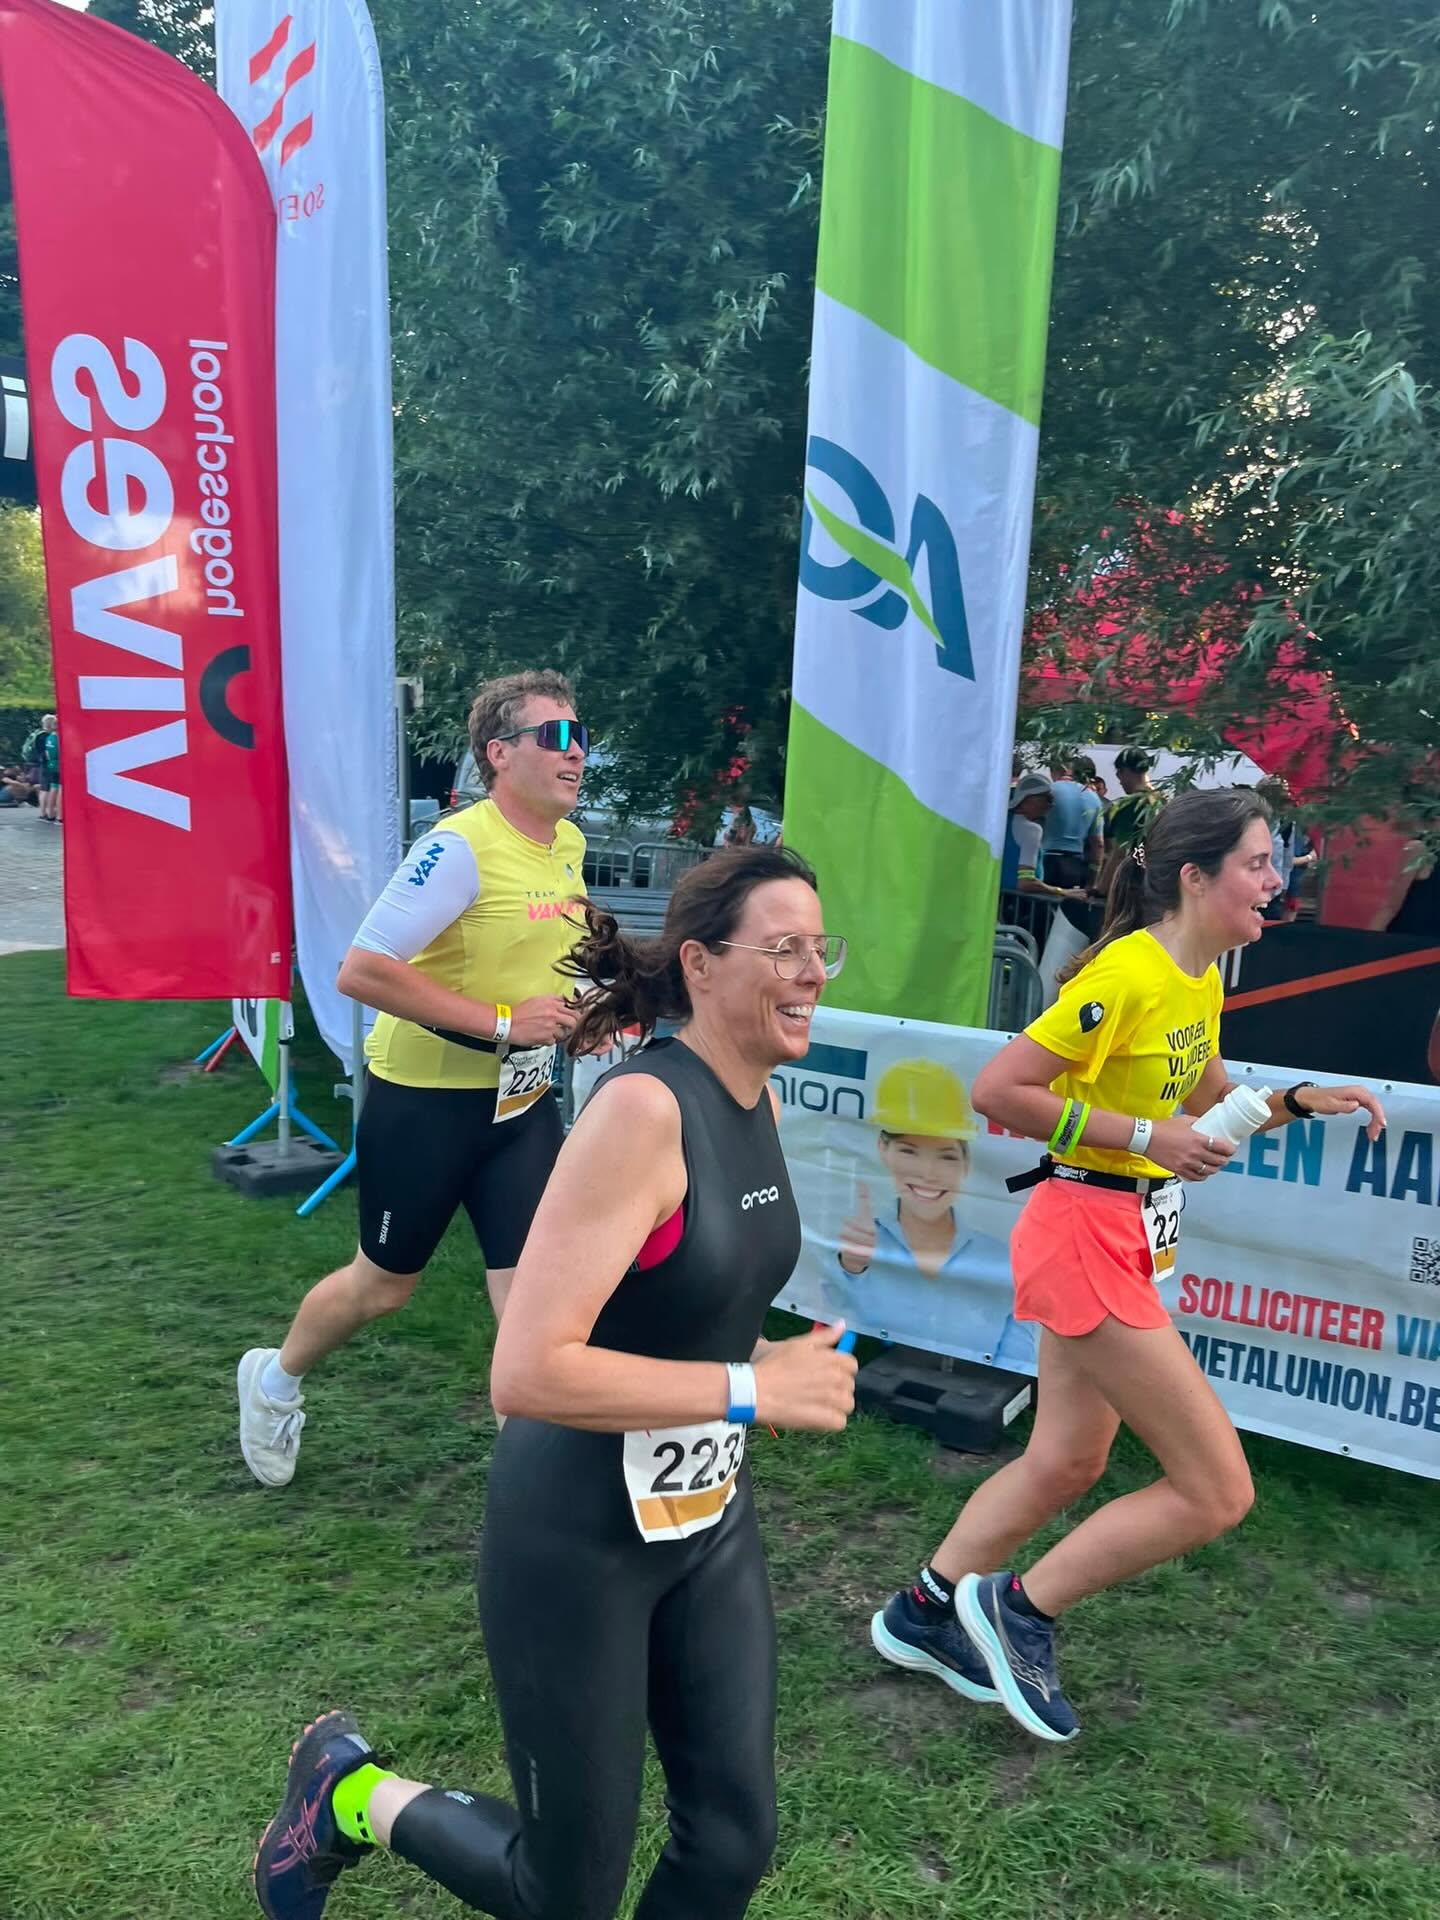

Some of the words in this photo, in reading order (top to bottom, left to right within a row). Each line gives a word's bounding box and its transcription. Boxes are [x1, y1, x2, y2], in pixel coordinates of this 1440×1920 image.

[408, 843, 446, 887] VAN
[507, 1055, 554, 1097] 2233
[1220, 1118, 1326, 1187] EN
[1345, 1125, 1440, 1208] AA
[741, 1186, 779, 1210] orca
[1178, 1273, 1385, 1351] SOLLICITEER
